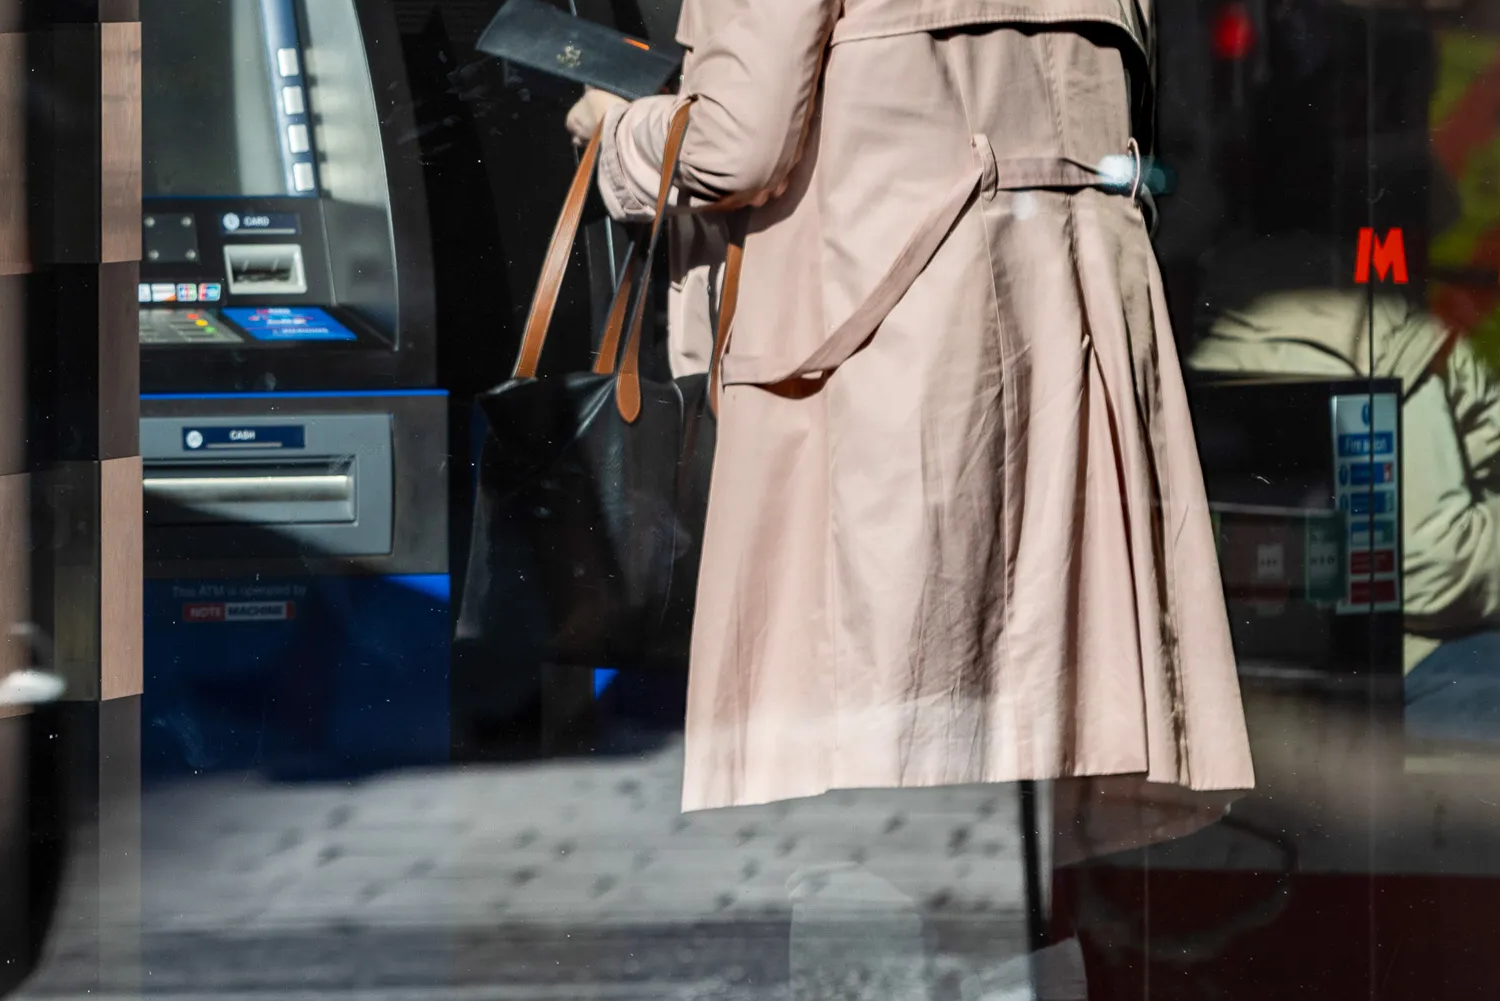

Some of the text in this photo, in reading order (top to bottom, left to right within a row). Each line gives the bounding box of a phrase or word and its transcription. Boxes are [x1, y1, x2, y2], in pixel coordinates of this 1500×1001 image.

[243, 215, 270, 227] CARD
[1353, 226, 1410, 284] M
[228, 429, 256, 441] CASH
[189, 606, 222, 618] NOTE
